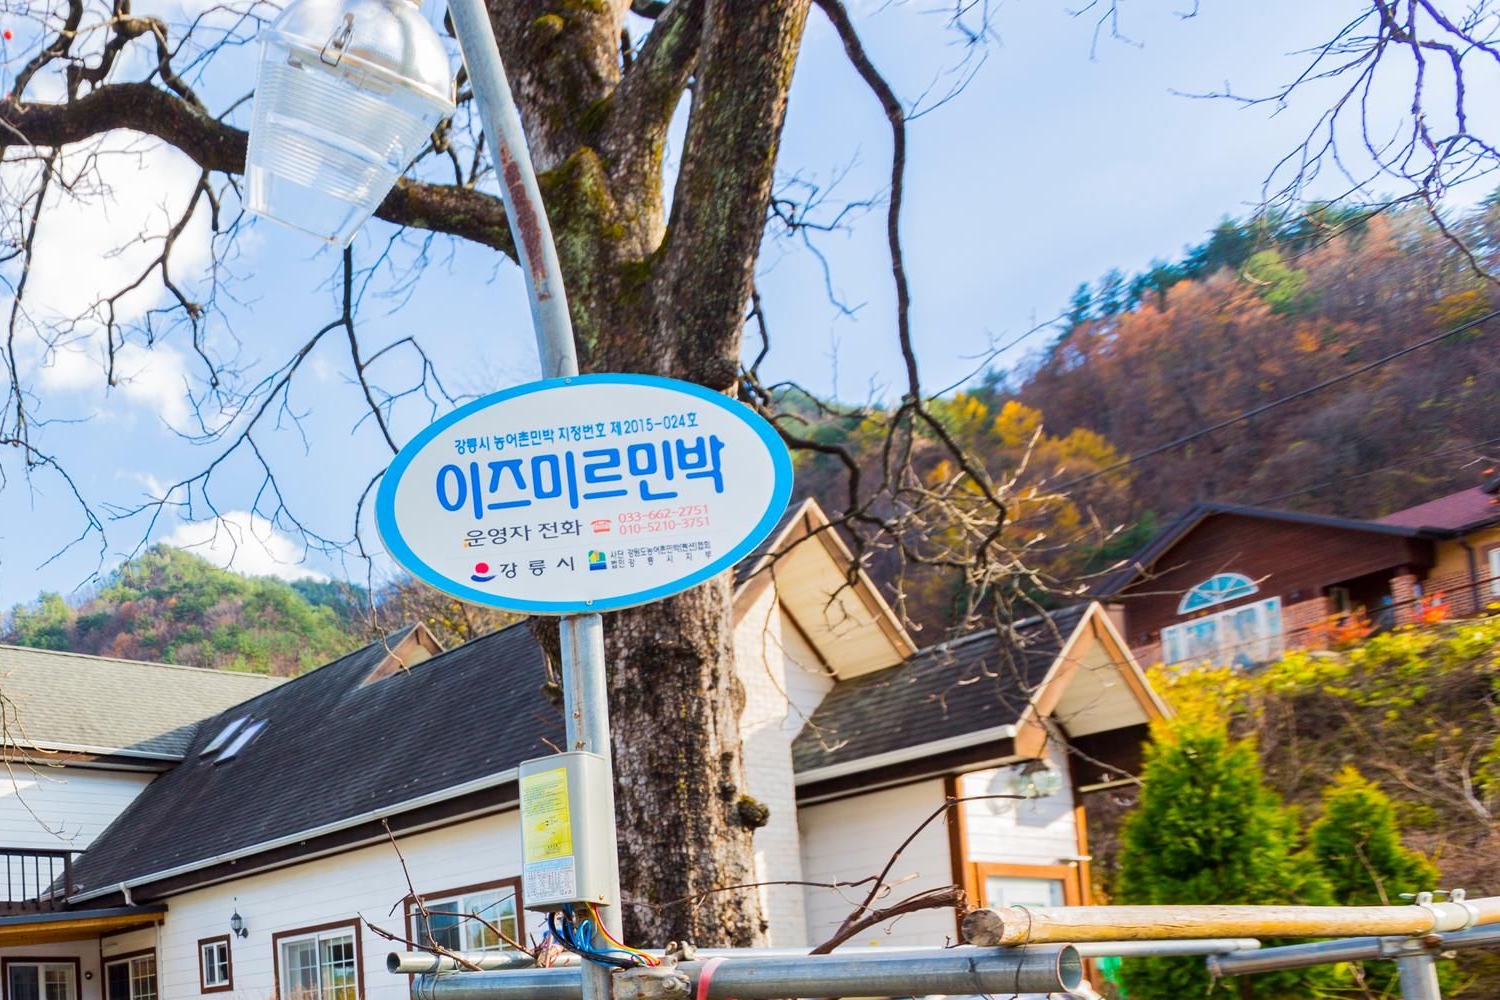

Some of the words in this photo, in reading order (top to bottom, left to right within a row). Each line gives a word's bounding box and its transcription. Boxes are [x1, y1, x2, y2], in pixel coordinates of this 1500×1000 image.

[454, 436, 491, 455] 강릉시
[493, 429, 555, 451] 농어촌민박
[558, 422, 607, 442] 지정번호
[436, 434, 725, 520] 이즈미르민박
[464, 525, 532, 547] 운영자
[538, 519, 583, 540] 전화
[618, 504, 709, 523] 033-662-2751
